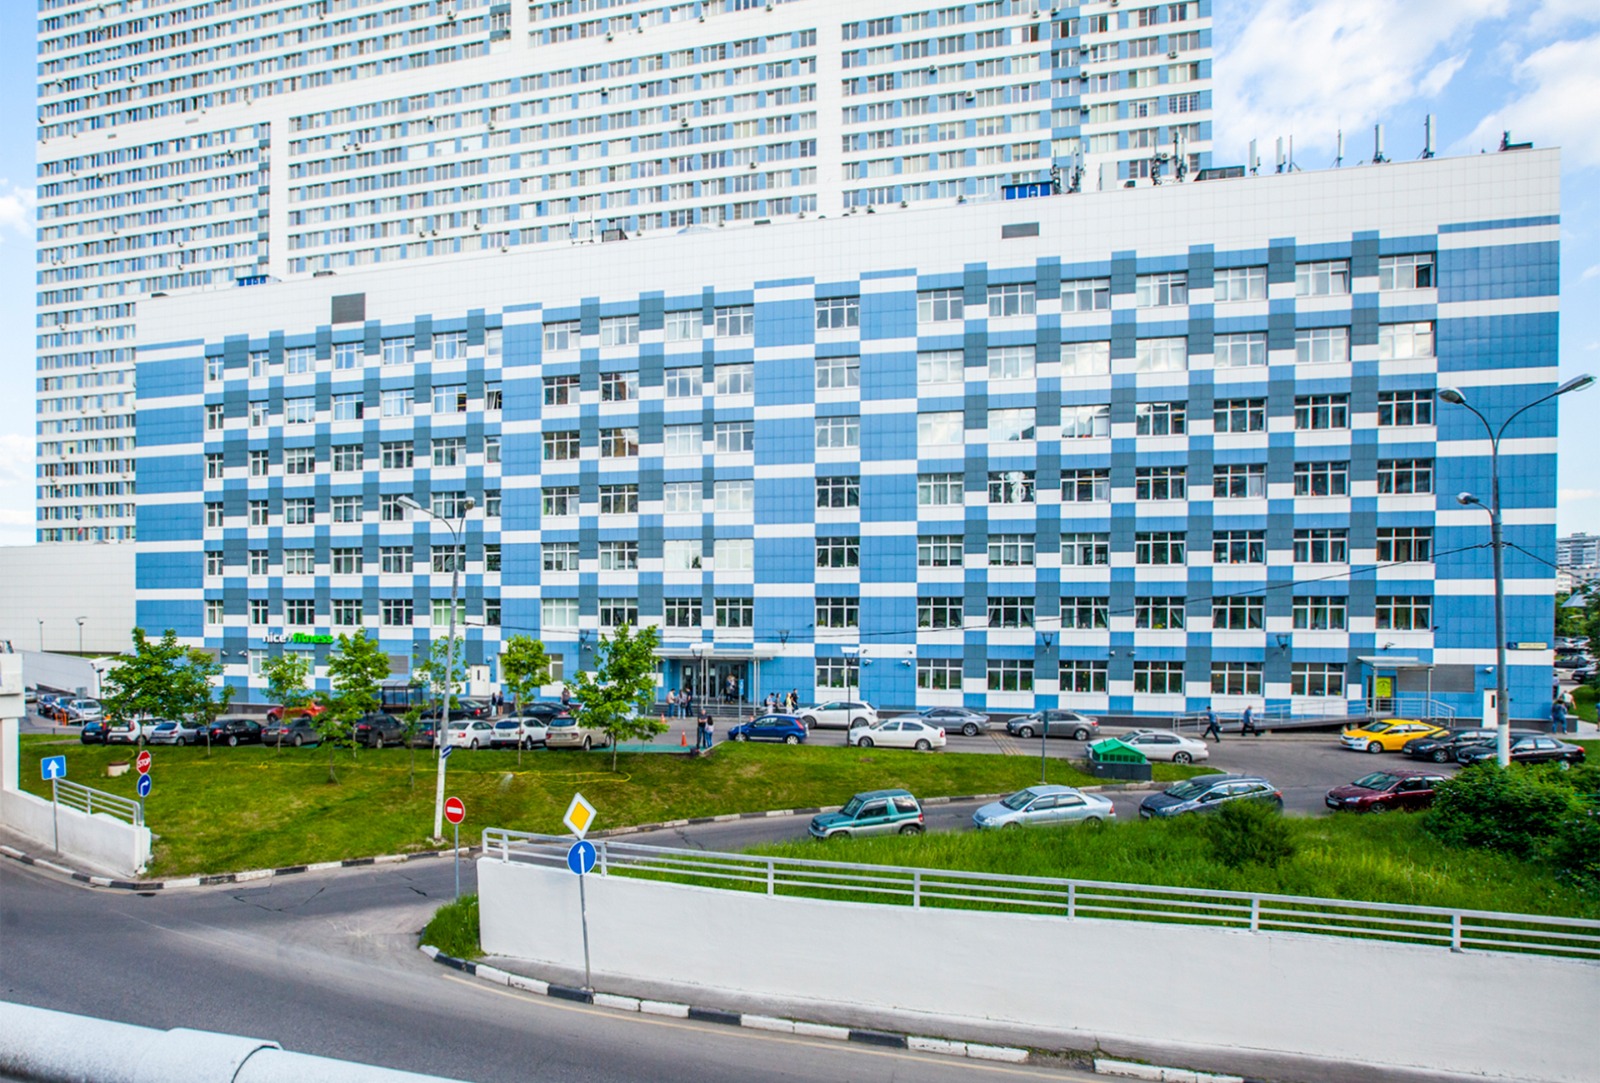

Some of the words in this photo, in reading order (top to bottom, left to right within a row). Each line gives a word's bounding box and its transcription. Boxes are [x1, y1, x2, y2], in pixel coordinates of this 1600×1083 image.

[263, 632, 286, 643] nice
[293, 632, 333, 644] fitness
[138, 757, 151, 768] STOP
